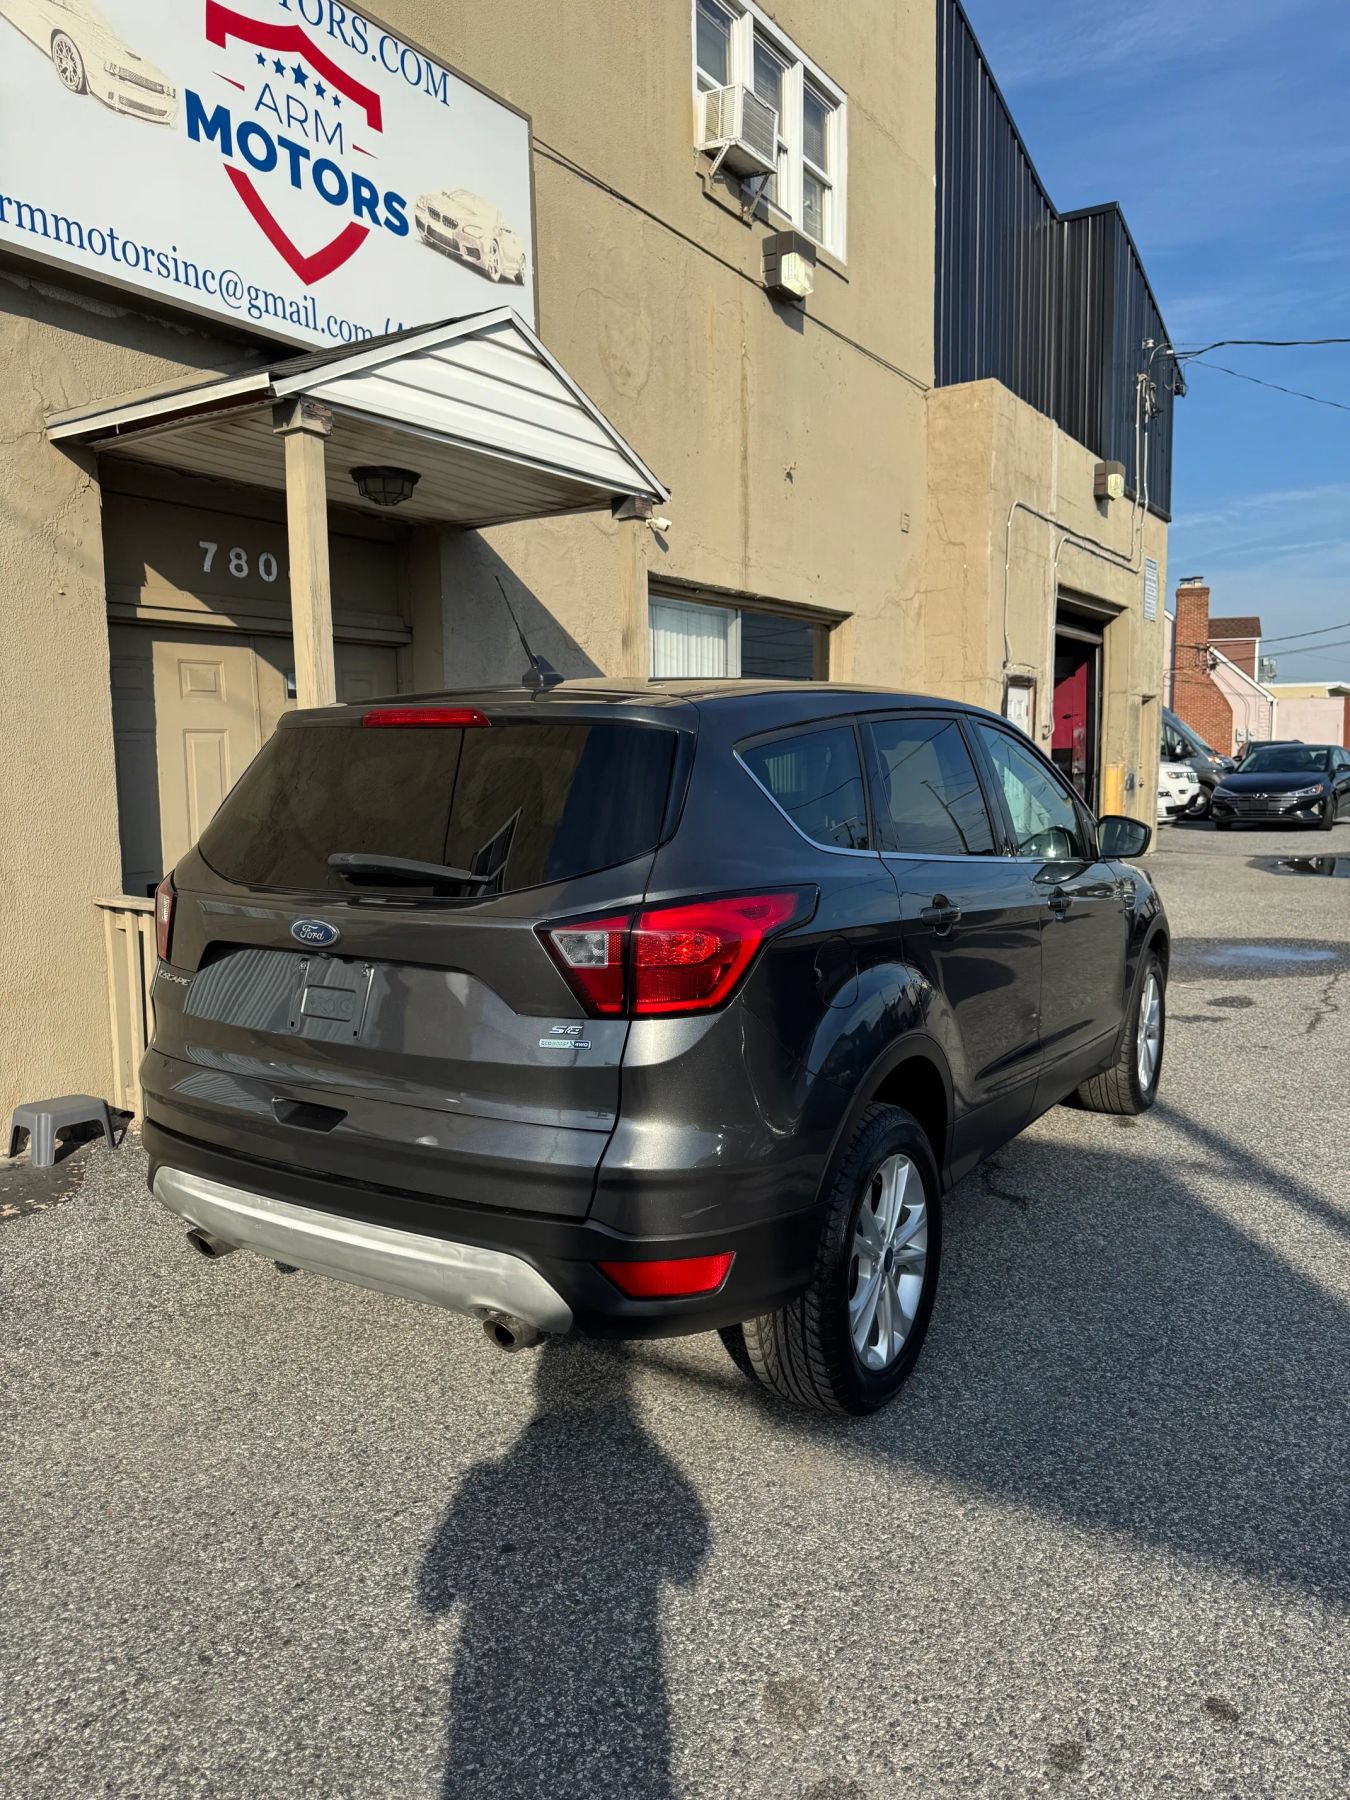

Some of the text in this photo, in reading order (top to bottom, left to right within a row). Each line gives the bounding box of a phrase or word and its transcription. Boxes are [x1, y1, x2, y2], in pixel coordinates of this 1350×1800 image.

[278, 0, 450, 107] ORS.COM
[255, 83, 344, 155] ARM
[185, 88, 409, 237] MOTORS
[200, 541, 291, 582] 780
[300, 924, 325, 940] Ford
[549, 1026, 582, 1034] SE
